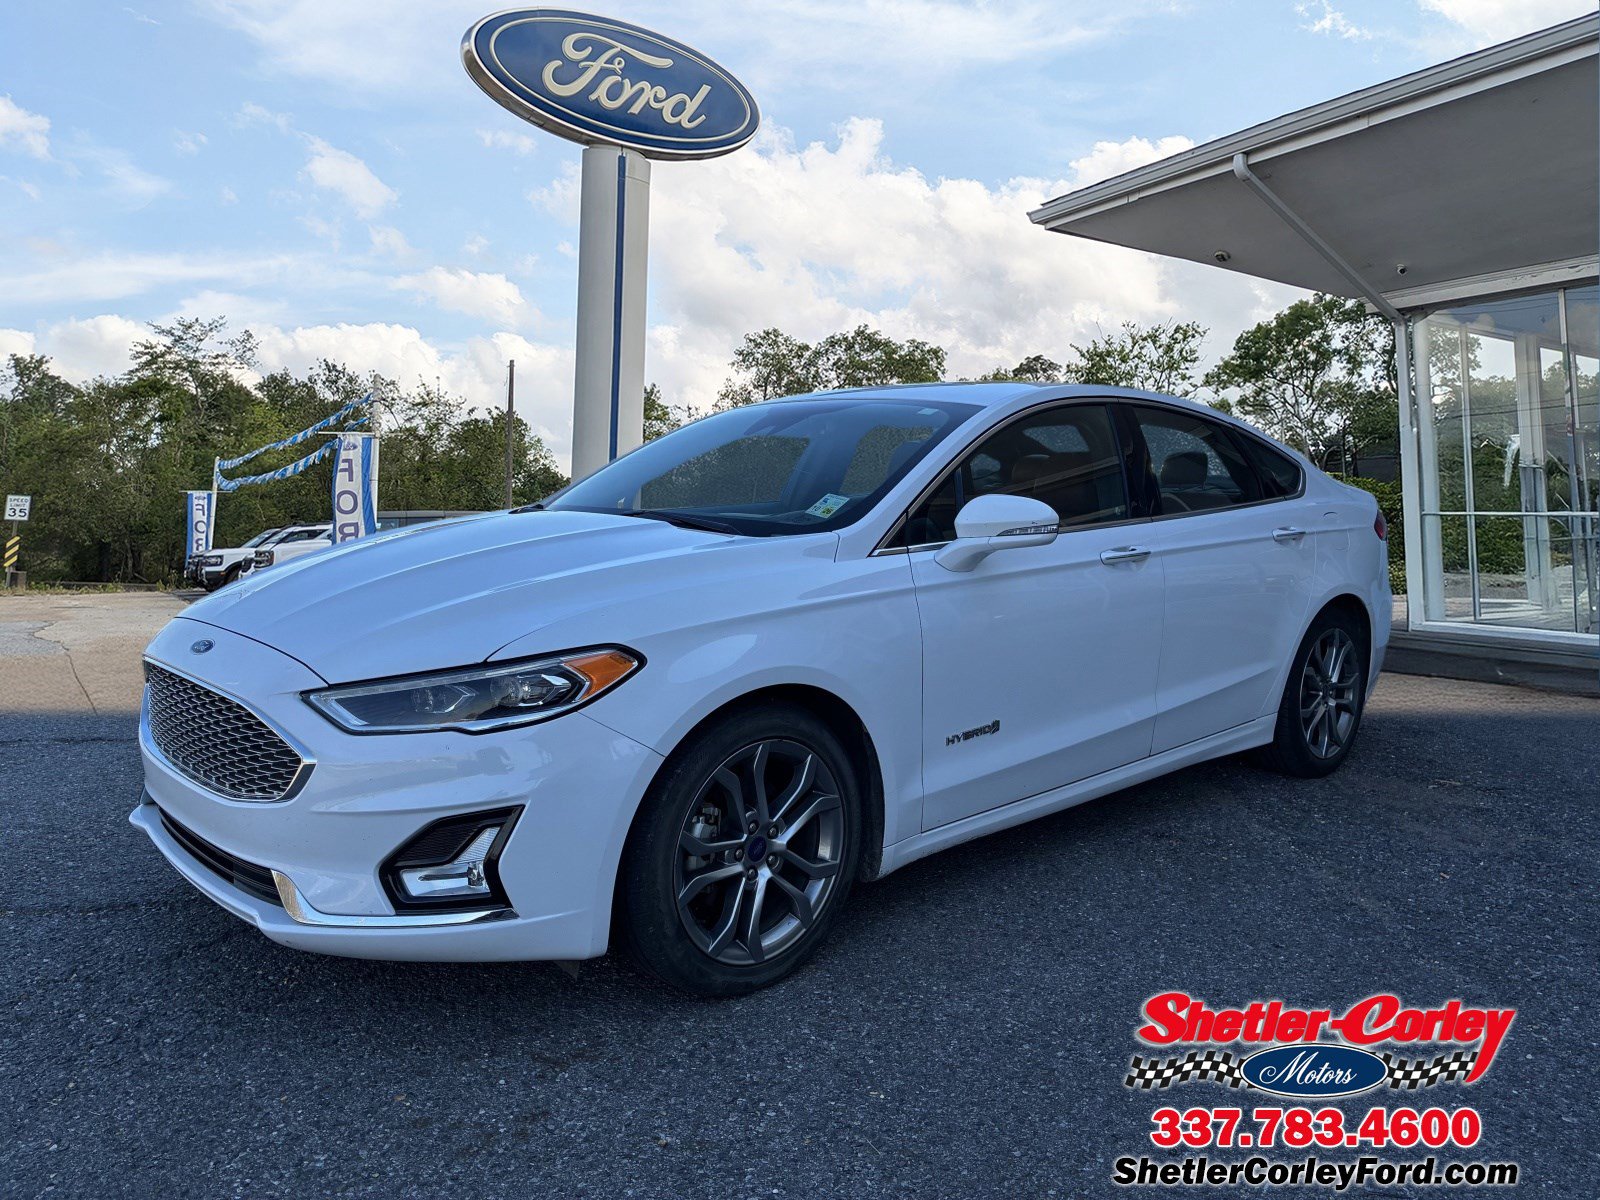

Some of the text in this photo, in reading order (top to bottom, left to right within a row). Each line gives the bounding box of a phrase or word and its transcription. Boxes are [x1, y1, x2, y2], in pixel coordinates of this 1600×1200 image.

[541, 32, 712, 129] Ford
[8, 507, 27, 517] 35
[945, 724, 992, 746] HYBRID
